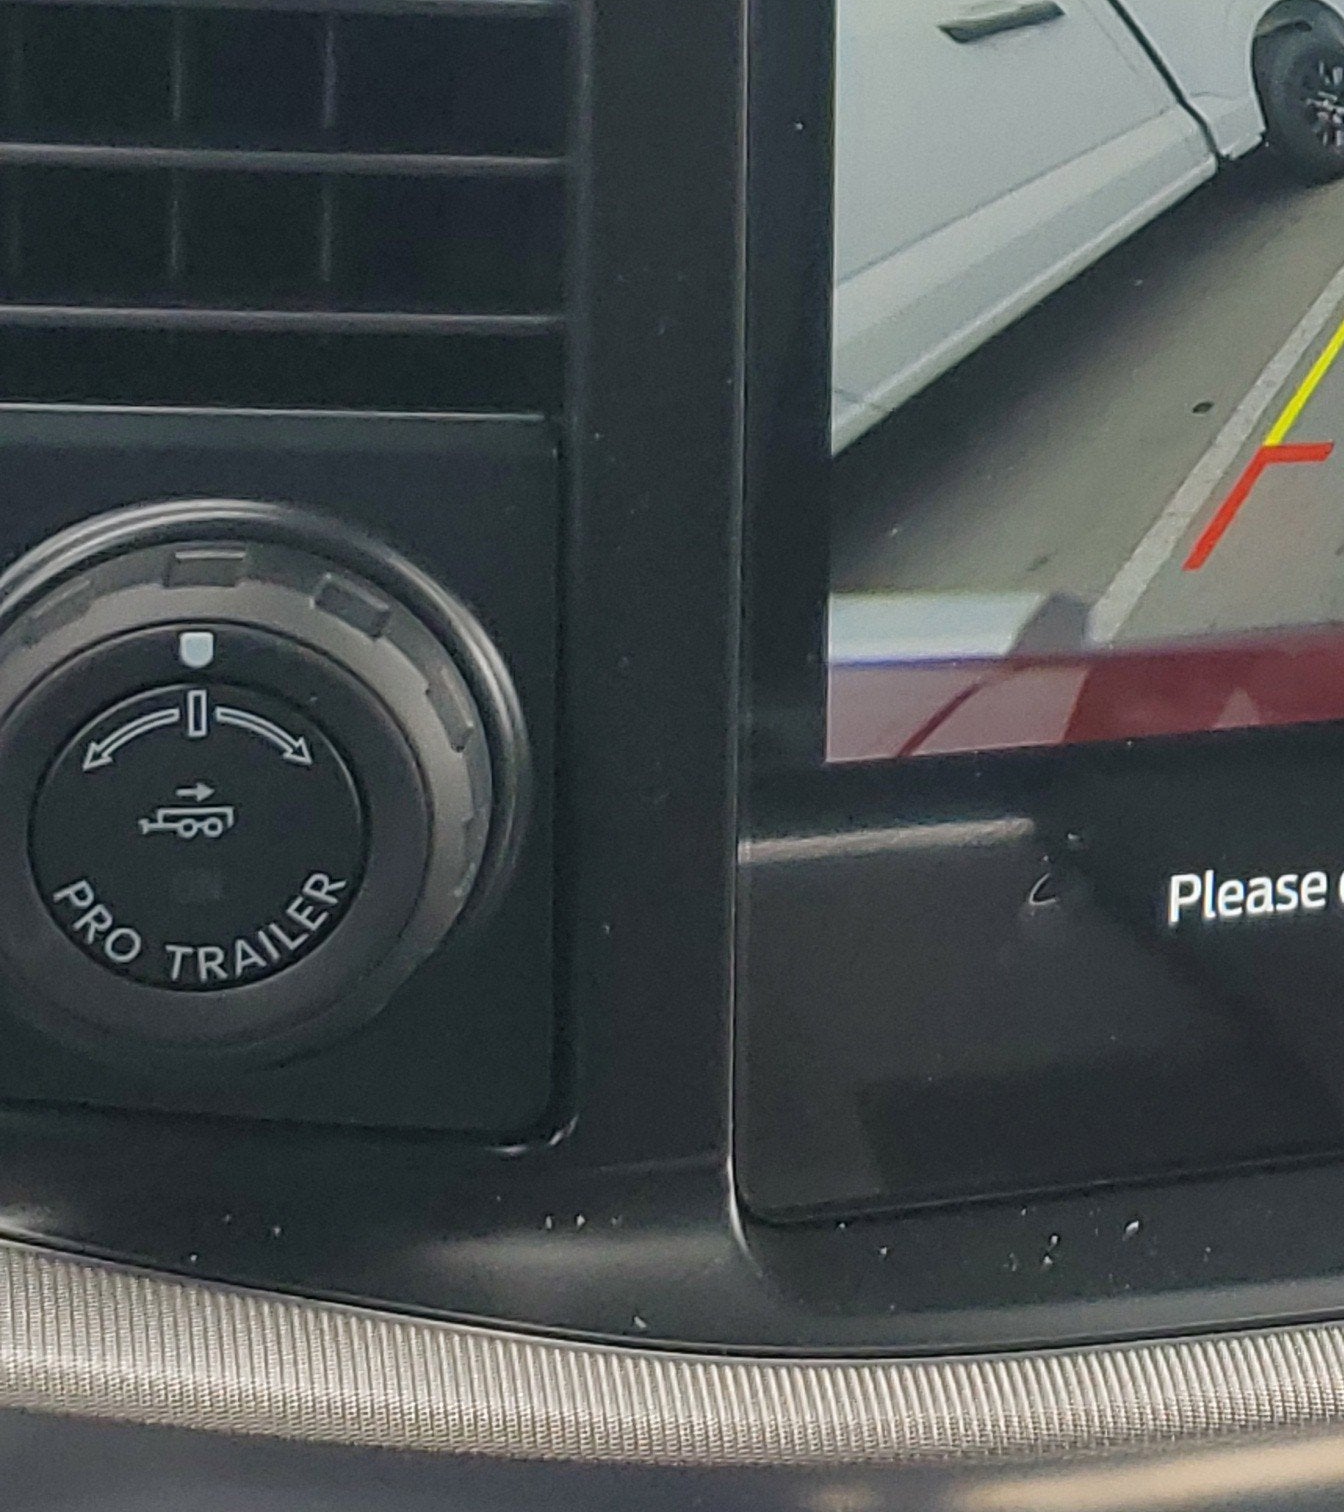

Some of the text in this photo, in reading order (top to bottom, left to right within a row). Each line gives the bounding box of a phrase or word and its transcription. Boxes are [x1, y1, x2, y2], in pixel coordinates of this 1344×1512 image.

[53, 871, 348, 982] PRO TRAILER
[1166, 871, 1328, 927] Please
